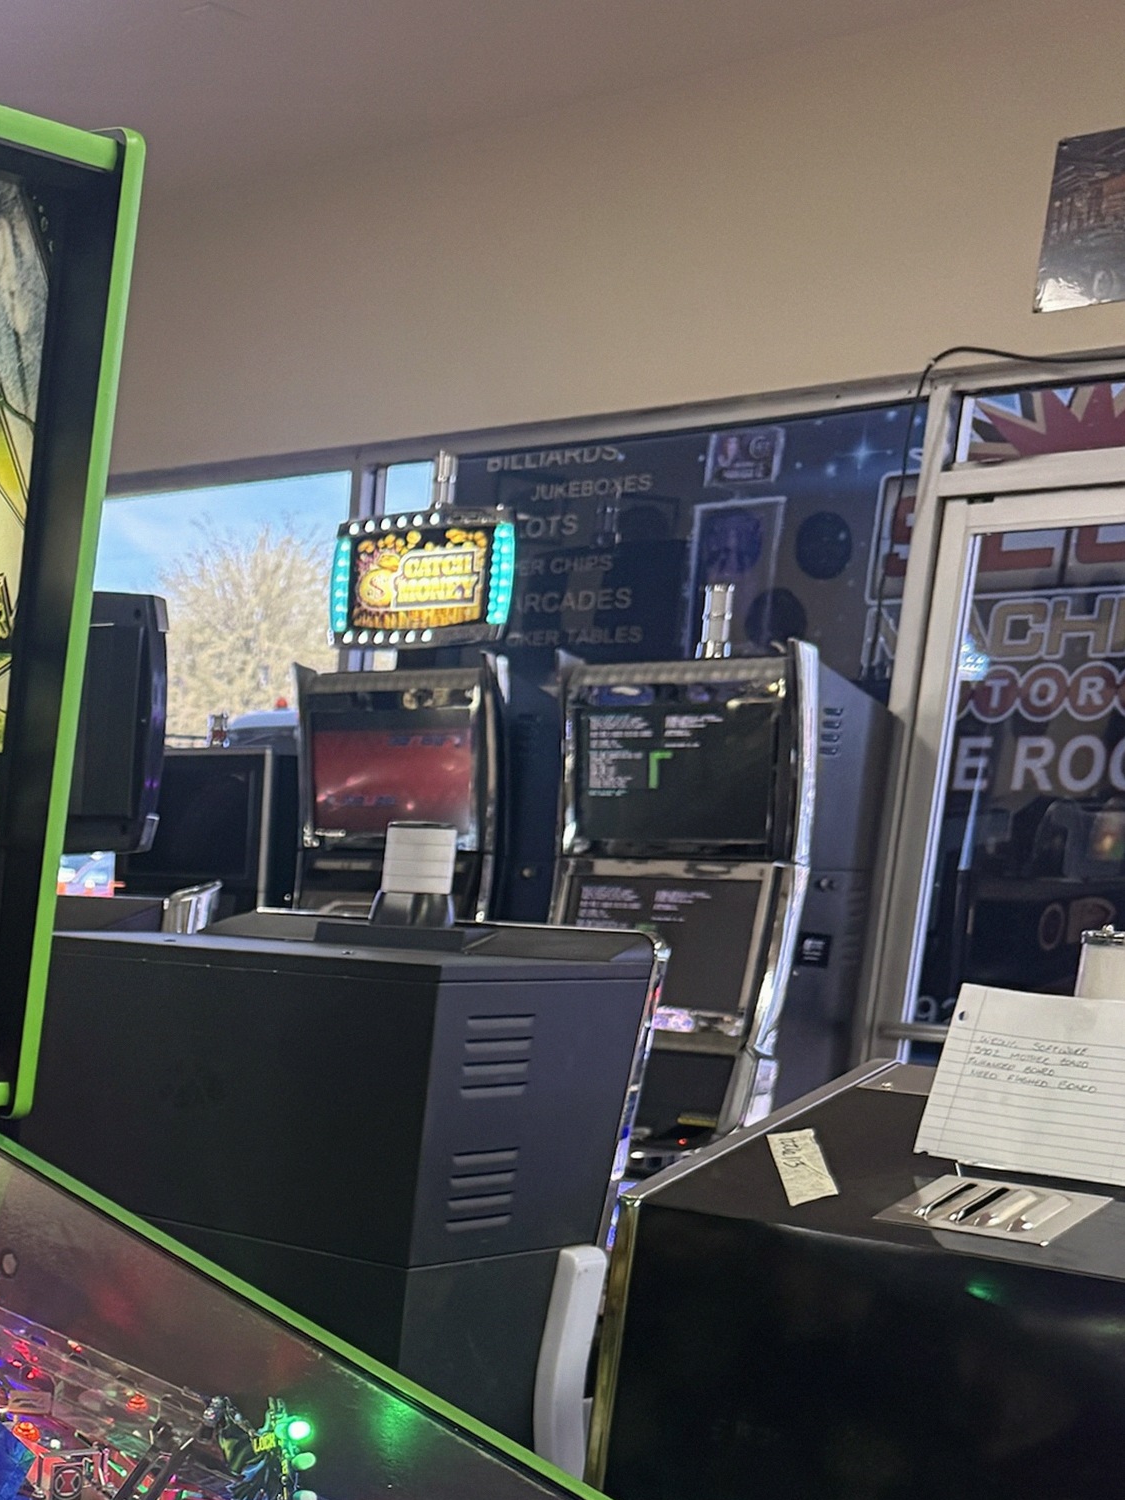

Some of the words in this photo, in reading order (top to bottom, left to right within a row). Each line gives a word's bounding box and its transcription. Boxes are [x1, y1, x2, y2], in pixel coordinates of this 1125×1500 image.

[531, 474, 653, 501] JUKEBOXES
[403, 554, 473, 579] CATCH
[566, 624, 643, 647] TABLES
